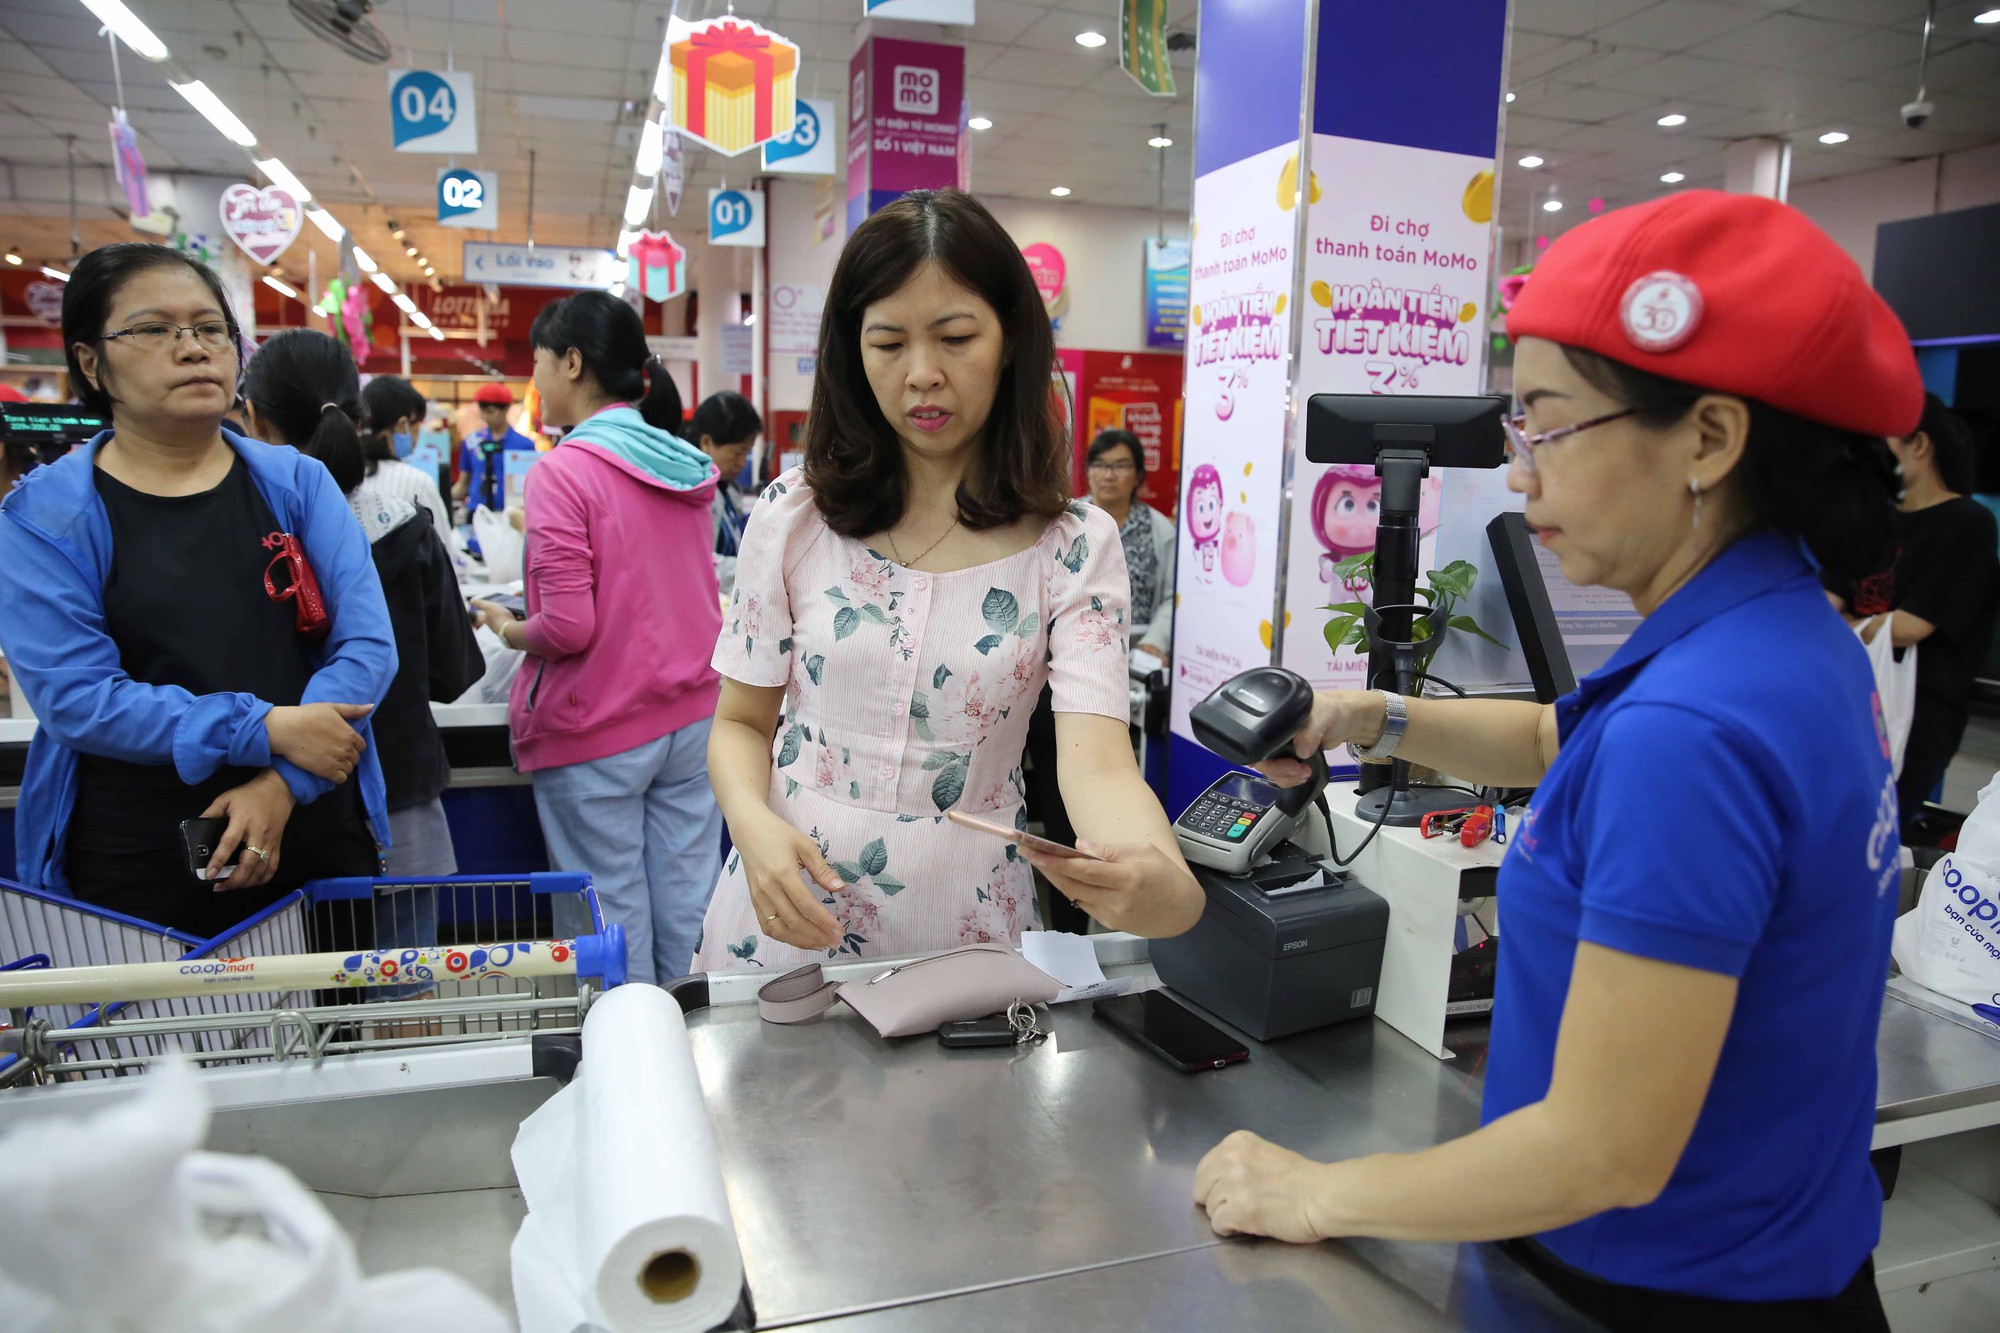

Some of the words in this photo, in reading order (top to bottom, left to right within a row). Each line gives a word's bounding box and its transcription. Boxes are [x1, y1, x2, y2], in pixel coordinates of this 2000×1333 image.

[400, 85, 453, 123] 04
[775, 112, 817, 147] 3
[894, 140, 900, 152] 1
[927, 143, 956, 157] NAM
[443, 177, 482, 209] 02
[715, 199, 746, 226] 01
[1370, 214, 1390, 233] Đi
[1396, 219, 1430, 242] chợ
[1220, 232, 1232, 248] Đi
[1235, 227, 1256, 246] chợ
[1195, 261, 1221, 280] thanh
[1224, 255, 1247, 273] toán
[1252, 246, 1287, 269] MoMo
[1316, 238, 1369, 259] thanh
[1376, 245, 1416, 264] toán
[1423, 249, 1477, 271] MoMo
[1202, 291, 1240, 328] HOÀN
[1240, 283, 1275, 321] TIỀN
[1332, 279, 1402, 314] HOÀN
[1404, 284, 1459, 325] TIỀN
[1194, 323, 1229, 367] TIẾT
[1230, 318, 1282, 365] KIỆM
[1314, 311, 1385, 355] TIẾT
[1388, 319, 1470, 366] KIỆM
[1326, 659, 1343, 673] TẢI
[1944, 904, 1965, 925] bạn
[1965, 924, 1985, 943] của
[1284, 939, 1308, 951] EPSON
[180, 963, 255, 976] co.opmart
